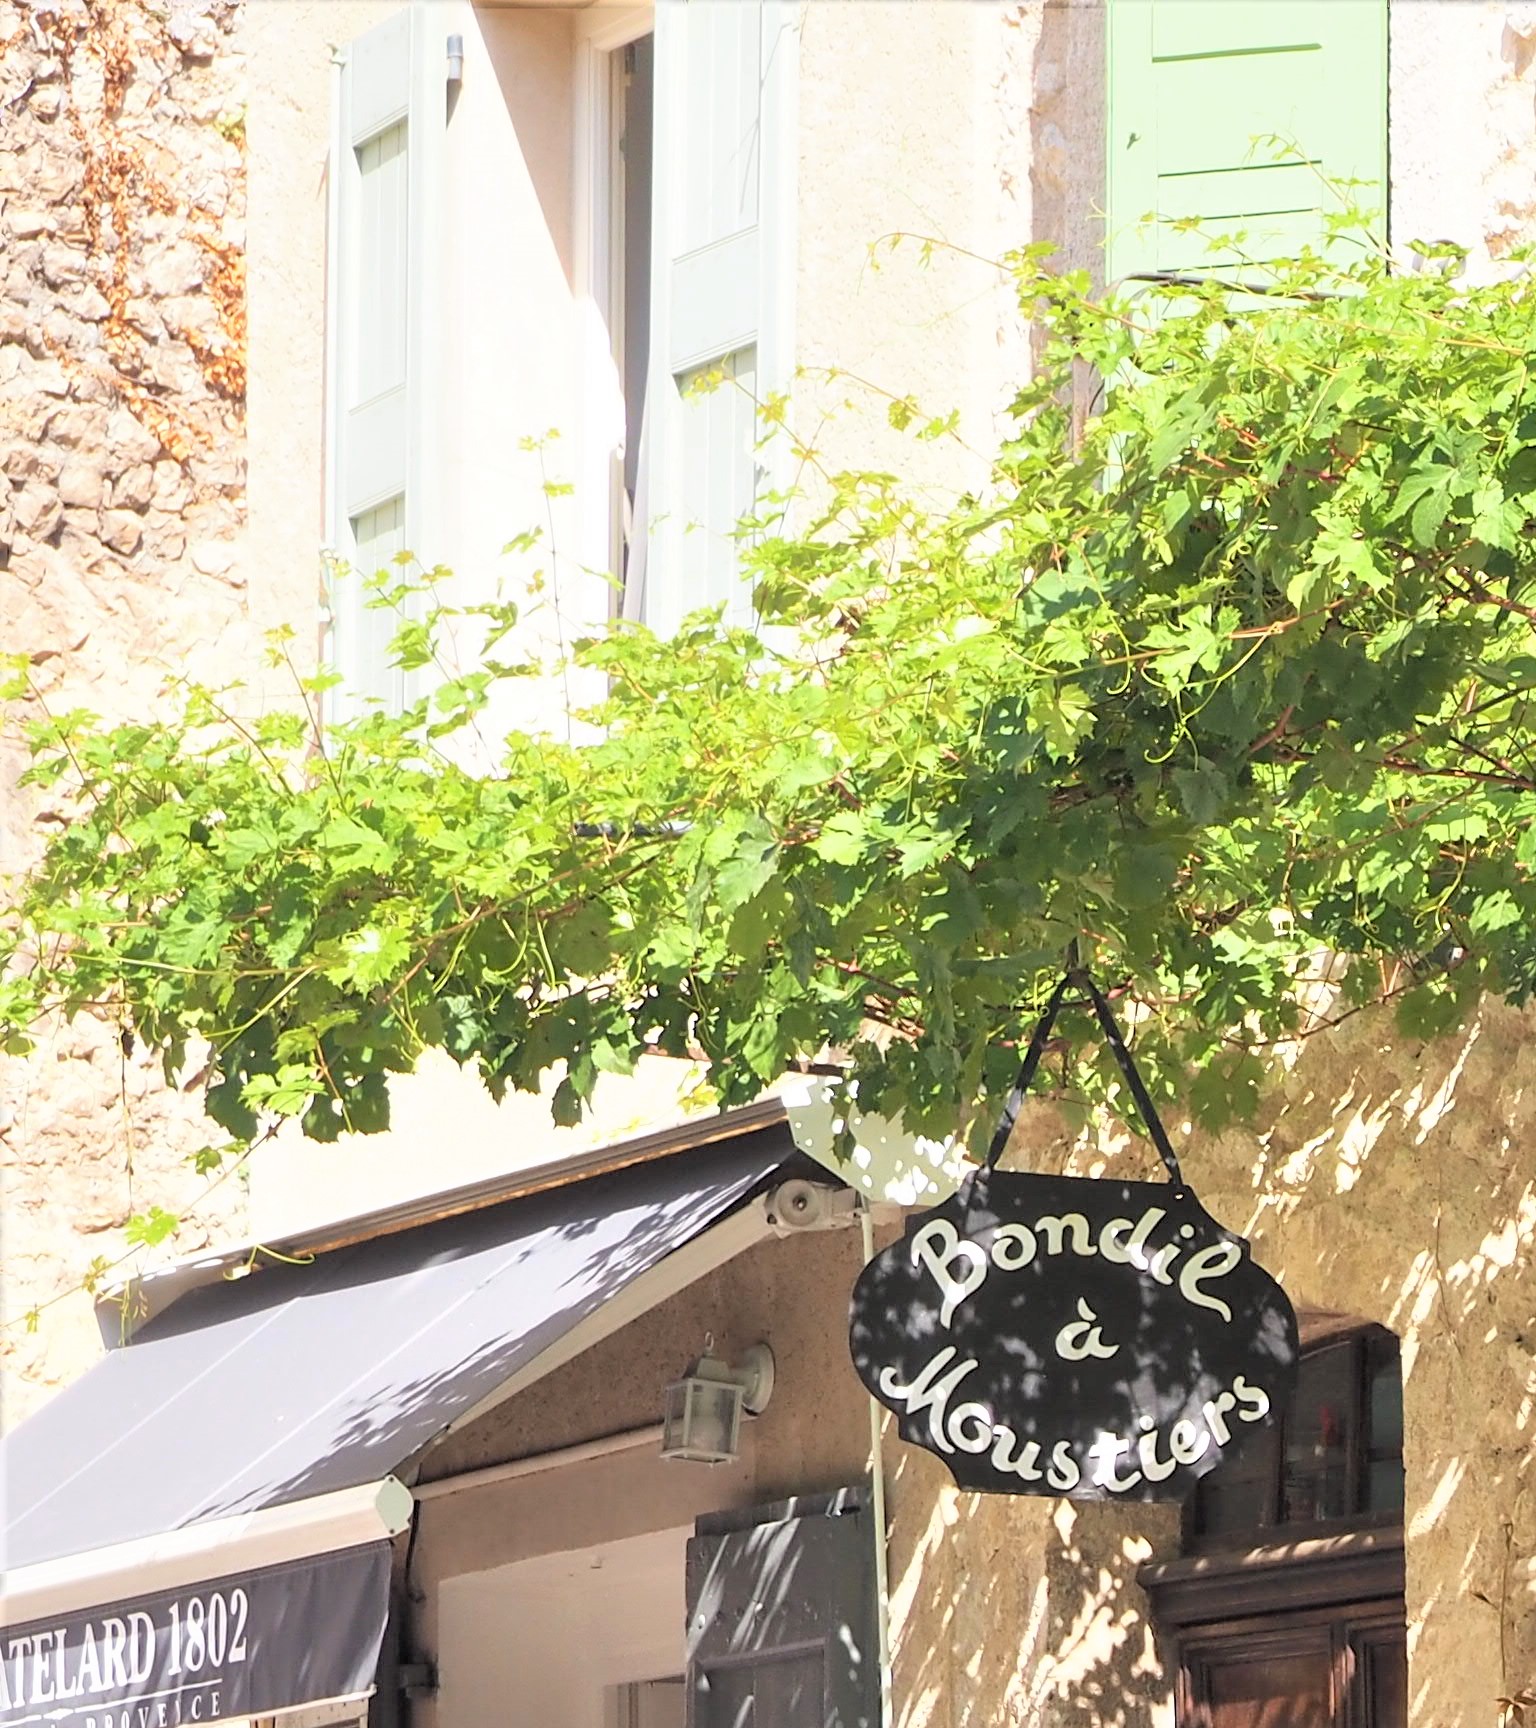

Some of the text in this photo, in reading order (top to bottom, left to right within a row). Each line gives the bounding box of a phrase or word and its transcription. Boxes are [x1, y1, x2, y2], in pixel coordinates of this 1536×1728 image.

[910, 1207, 1243, 1329] Bondil
[1055, 1296, 1120, 1361] à
[879, 1346, 1271, 1493] Moustiers
[168, 1588, 249, 1676] 1802
